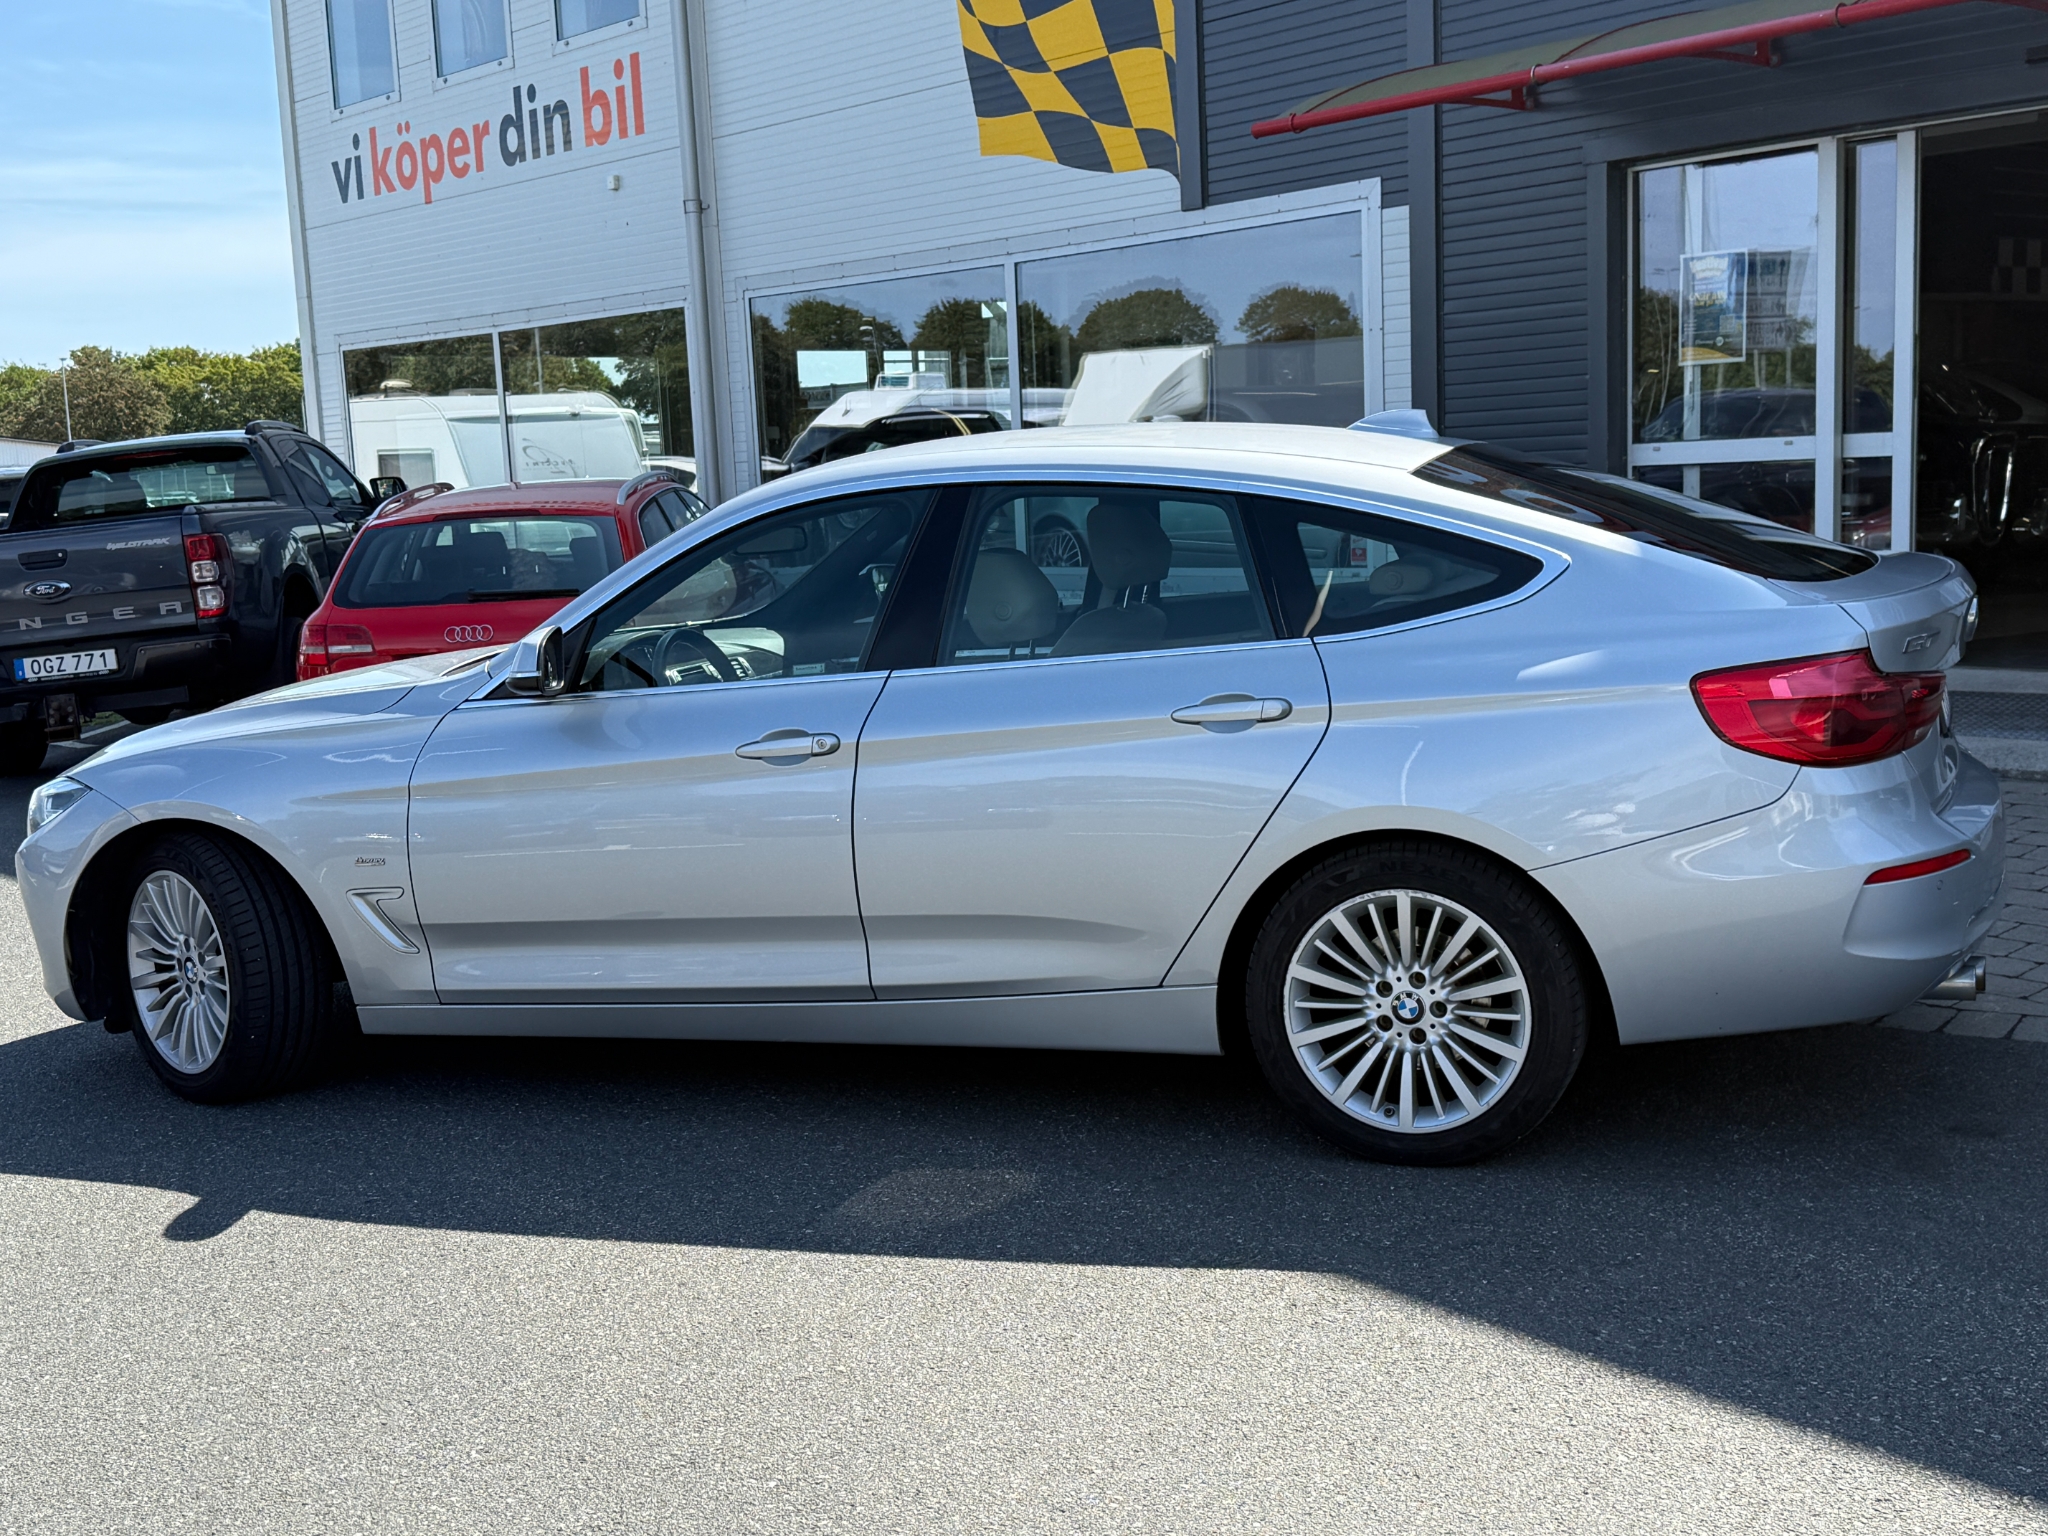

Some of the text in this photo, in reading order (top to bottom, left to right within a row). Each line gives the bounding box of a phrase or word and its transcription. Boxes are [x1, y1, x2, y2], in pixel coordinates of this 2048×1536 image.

[331, 52, 646, 204] vi köper din bil
[35, 585, 56, 595] Ford
[30, 652, 107, 675] OGZ 771
